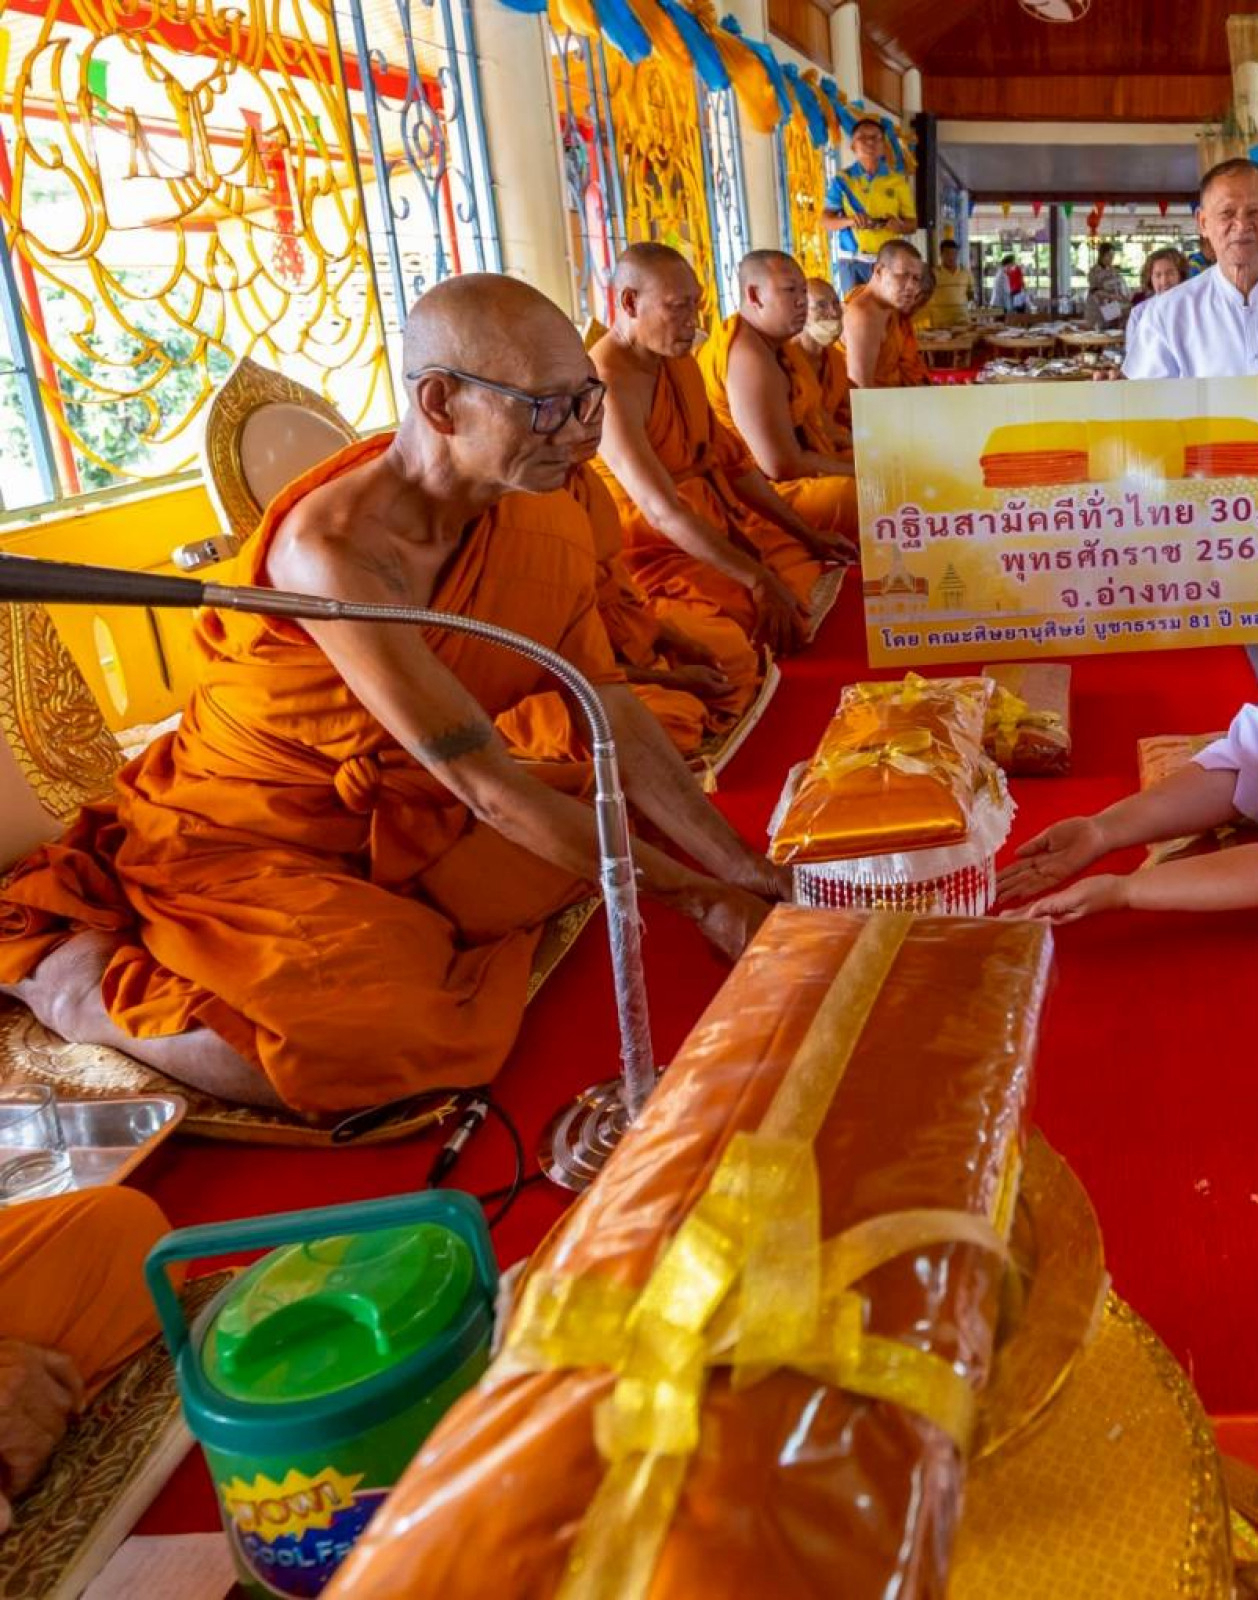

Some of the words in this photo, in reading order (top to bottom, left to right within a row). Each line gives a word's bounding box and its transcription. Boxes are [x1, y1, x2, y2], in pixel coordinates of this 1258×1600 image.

[875, 489, 1194, 549] กฐินสามัคคีทั่วไทย
[1001, 538, 1181, 583] พุทธศักราช
[1060, 577, 1221, 609] จ.อ่างทอง
[882, 629, 920, 648] โดย
[928, 618, 1086, 645] คณะศิษยานุศิษย์
[1094, 617, 1182, 641] บูชาธรรม
[1189, 613, 1210, 629] 81
[1218, 610, 1232, 627] ปี
